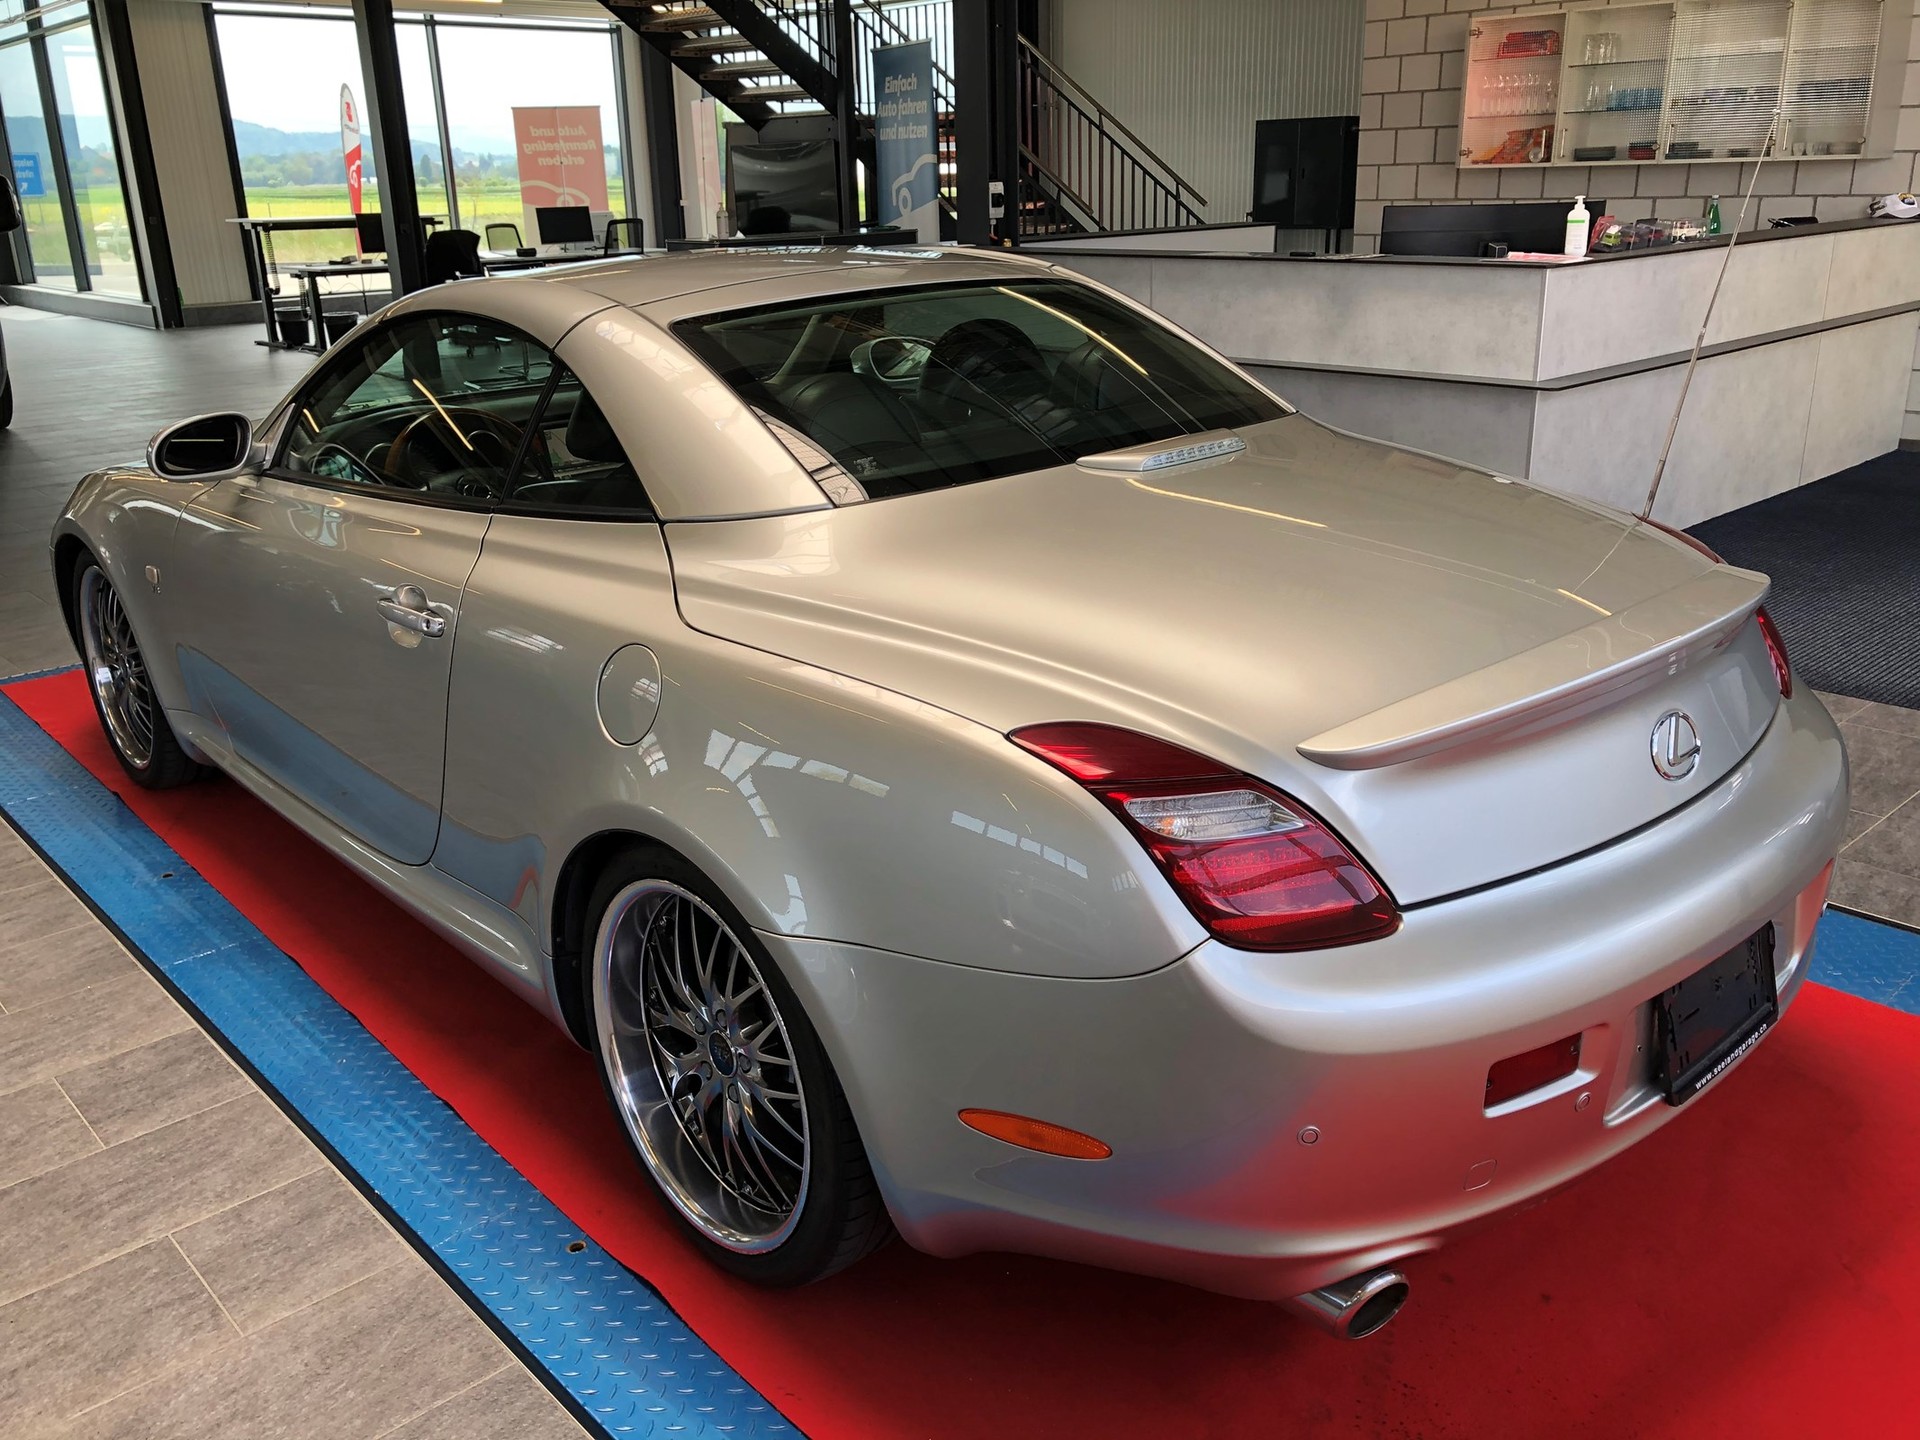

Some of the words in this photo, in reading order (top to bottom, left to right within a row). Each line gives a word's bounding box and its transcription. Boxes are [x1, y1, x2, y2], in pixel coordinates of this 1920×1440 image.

[885, 73, 917, 96] Einfach
[878, 102, 897, 117] Auto
[898, 98, 927, 121] fahren
[880, 124, 897, 141] und
[898, 123, 928, 141] nutzen
